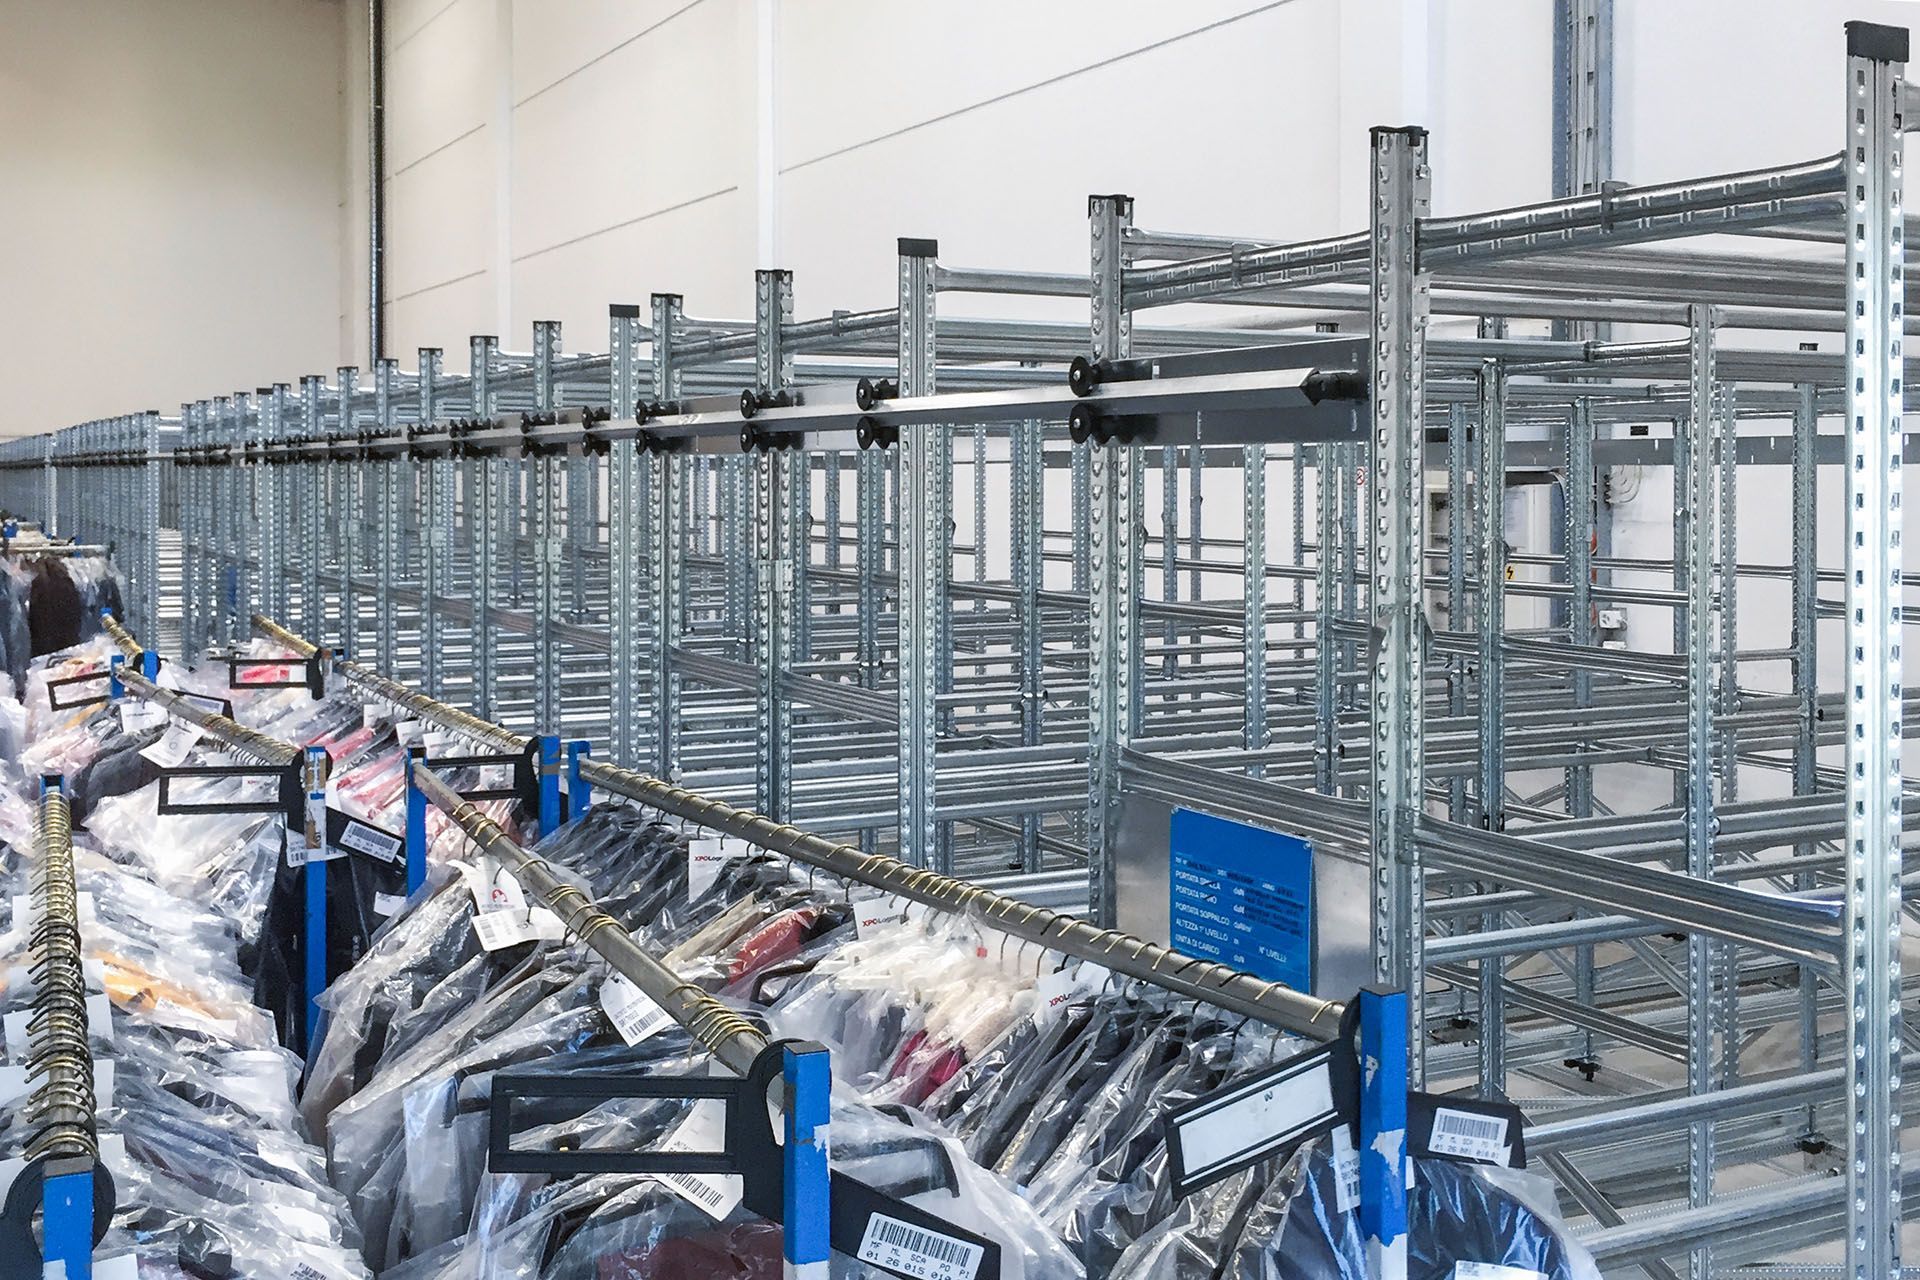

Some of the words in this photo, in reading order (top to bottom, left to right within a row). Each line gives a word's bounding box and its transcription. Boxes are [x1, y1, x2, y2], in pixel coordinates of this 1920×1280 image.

[866, 1250, 878, 1260] 01
[885, 1256, 900, 1267] 26
[904, 1262, 925, 1275] 015
[870, 1241, 882, 1249] MF
[890, 1247, 900, 1256] ML
[910, 1254, 926, 1264] SCA
[939, 1263, 950, 1272] PO
